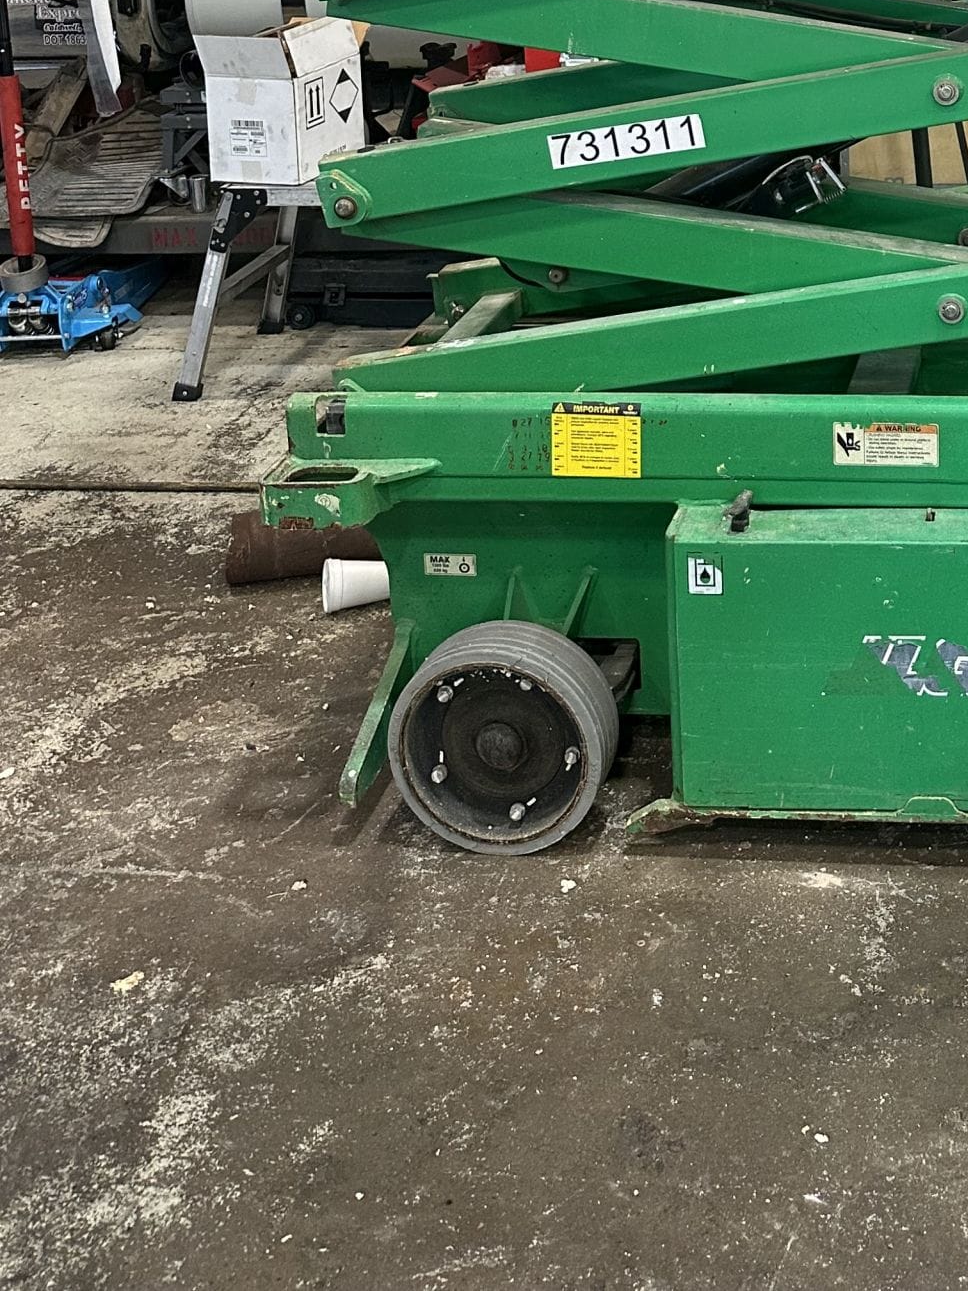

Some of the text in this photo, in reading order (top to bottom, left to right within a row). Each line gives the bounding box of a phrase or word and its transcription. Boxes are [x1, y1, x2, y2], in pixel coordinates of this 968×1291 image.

[43, 34, 63, 45] DOT
[551, 116, 695, 165] 731311
[573, 404, 620, 414] IMPORTANT
